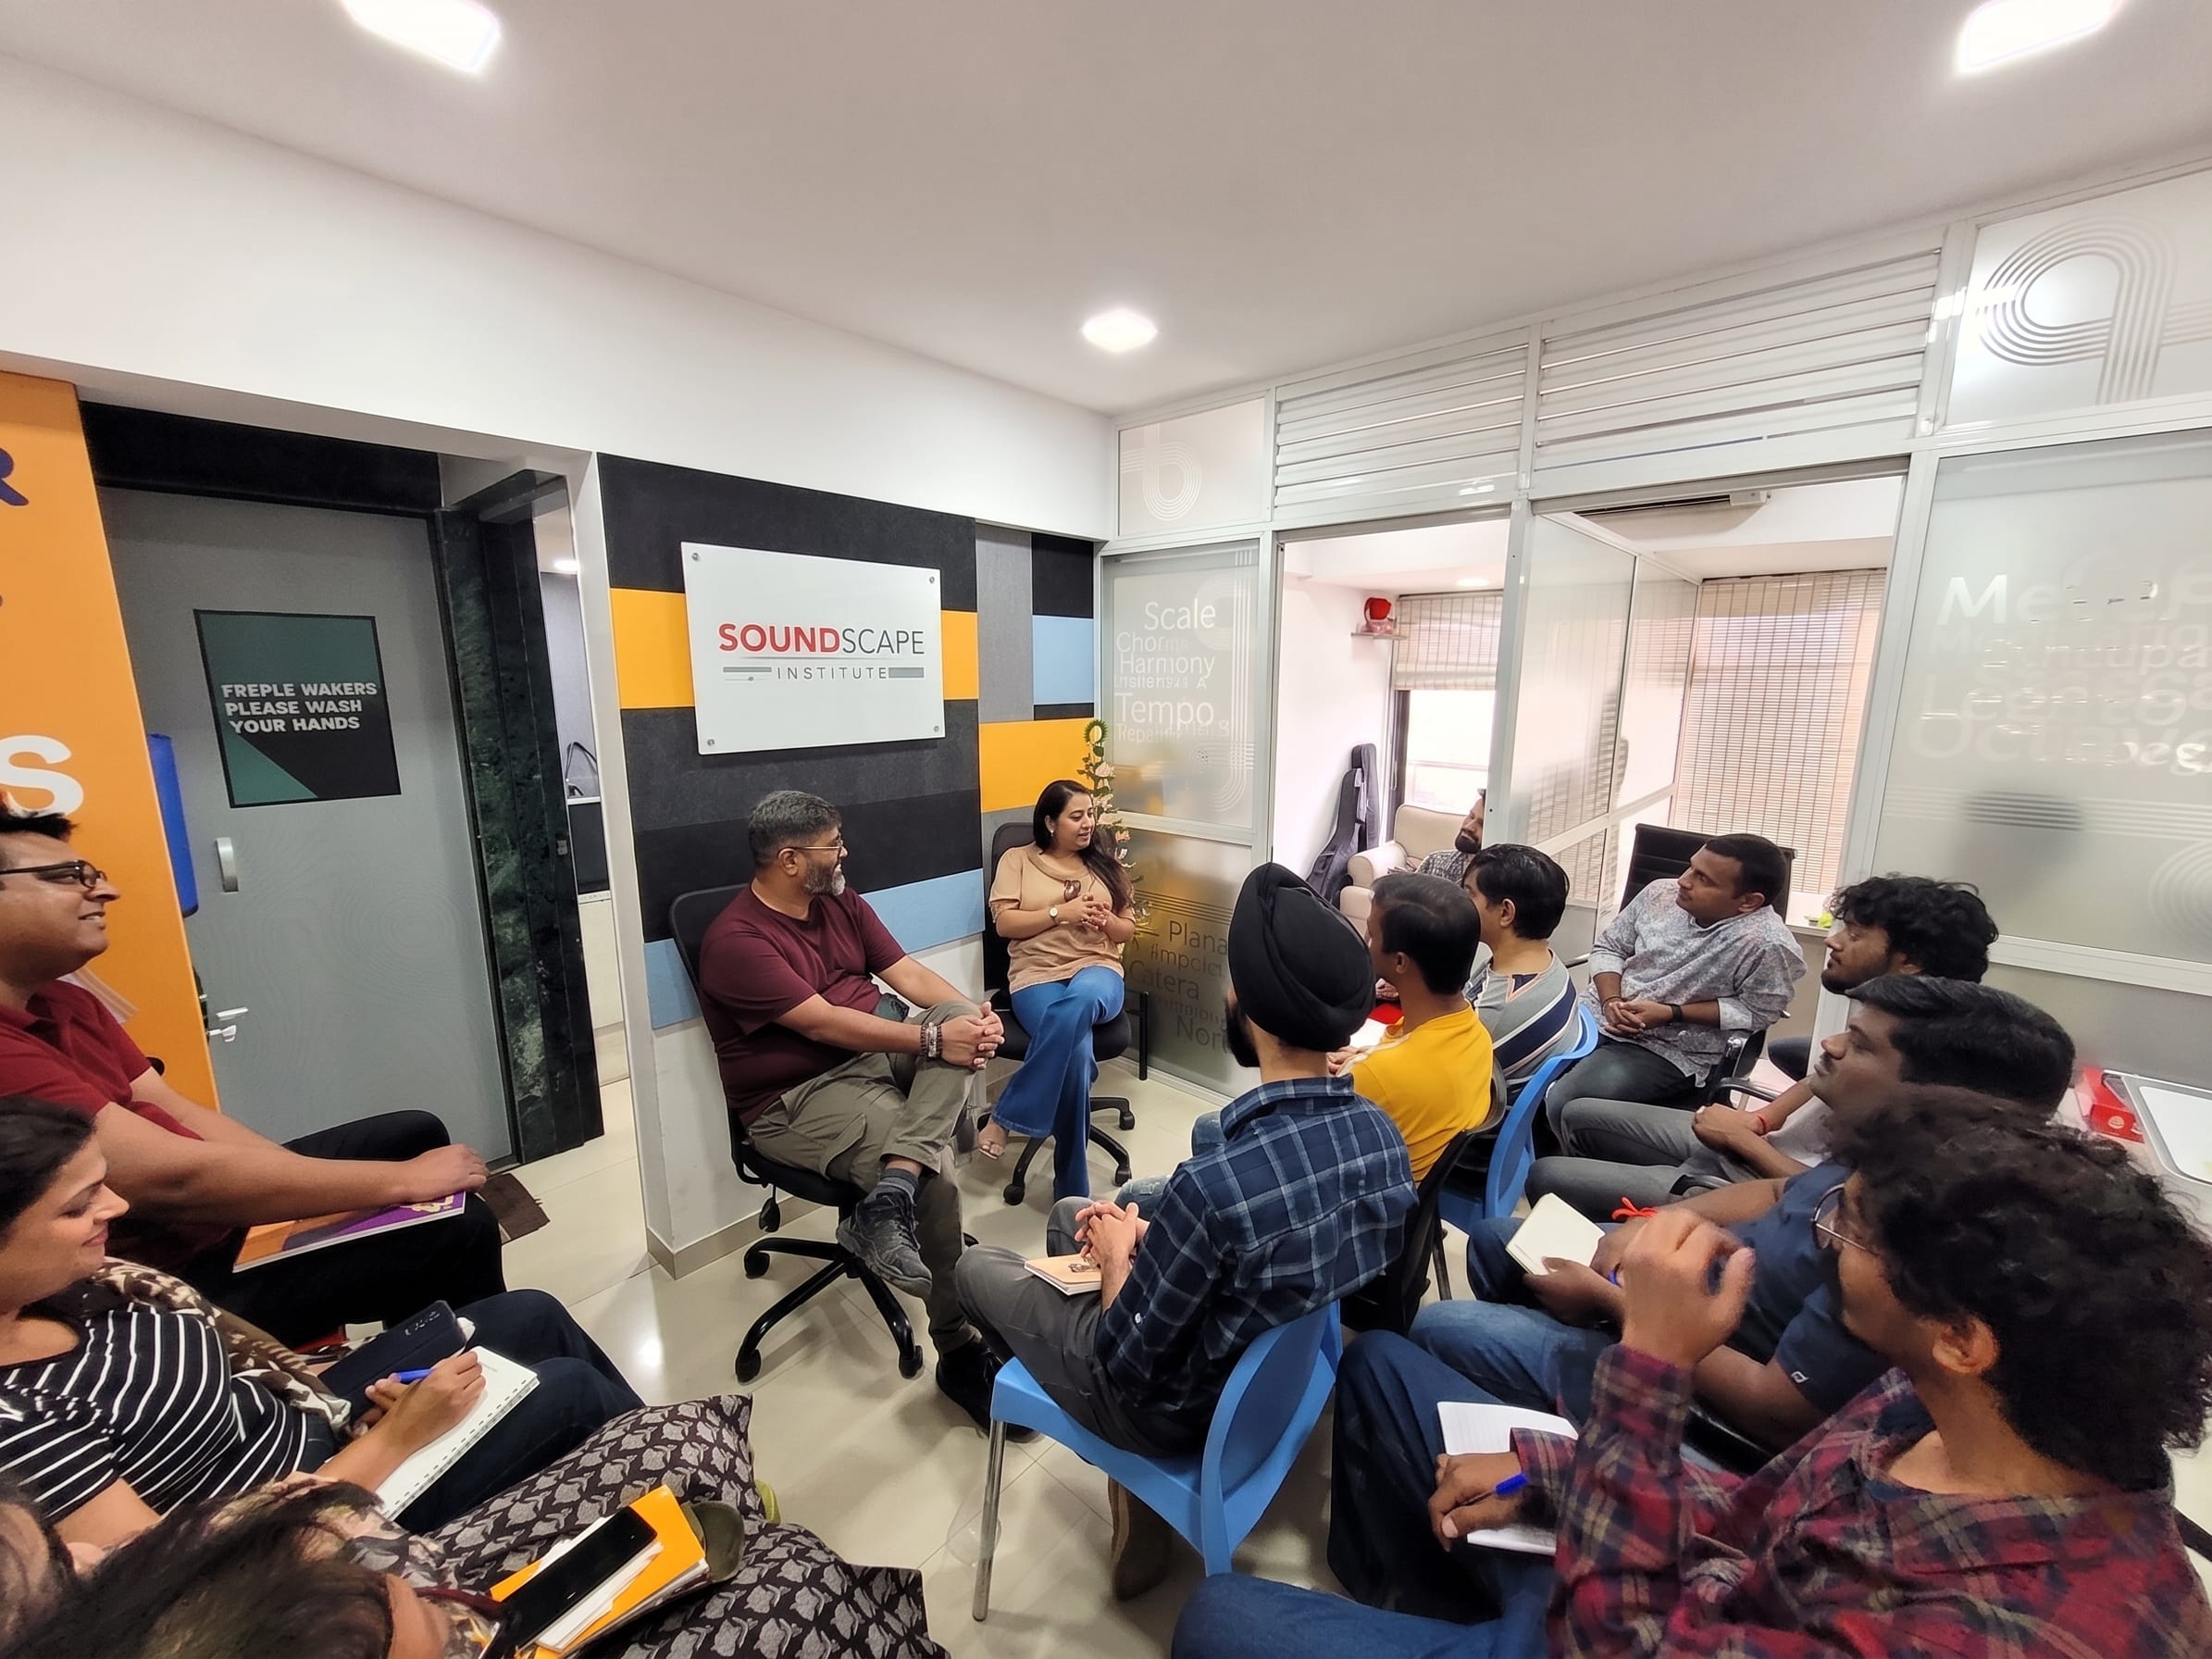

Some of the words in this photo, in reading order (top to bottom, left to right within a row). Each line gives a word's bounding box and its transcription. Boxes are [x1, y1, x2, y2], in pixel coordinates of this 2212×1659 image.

[1144, 598, 1216, 630] Scale
[718, 623, 924, 655] SOUNDSCAPE
[777, 667, 887, 680] INSTITUTE
[1120, 652, 1215, 679] Harmony
[221, 683, 295, 698] FREPLE
[301, 682, 378, 696] WAKERS
[226, 702, 300, 717] PLEASE
[304, 700, 362, 714] WASH
[1114, 692, 1214, 730] Tempo
[230, 719, 286, 733] YOUR
[292, 717, 360, 731] HANDS
